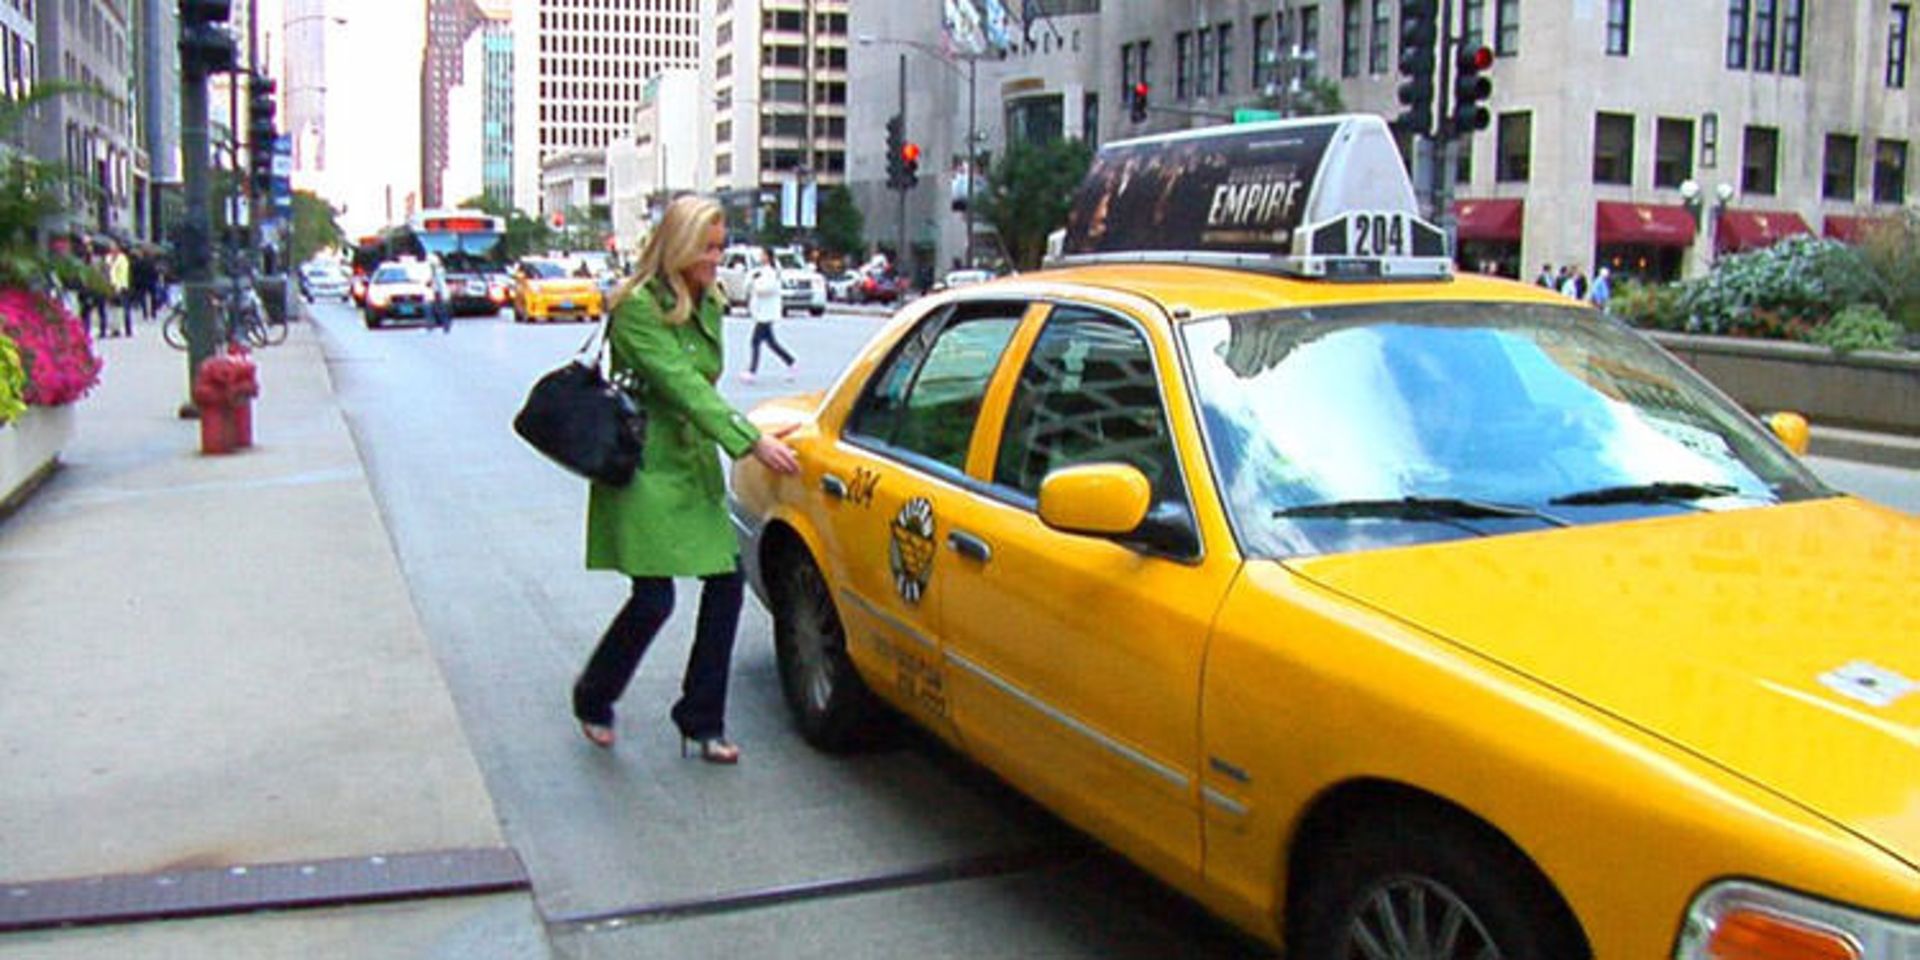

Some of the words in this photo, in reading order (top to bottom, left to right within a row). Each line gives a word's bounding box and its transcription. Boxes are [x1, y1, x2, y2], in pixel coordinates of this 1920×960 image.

[1207, 181, 1303, 225] EMPIRE
[1355, 214, 1403, 256] 204
[847, 465, 882, 510] 204
